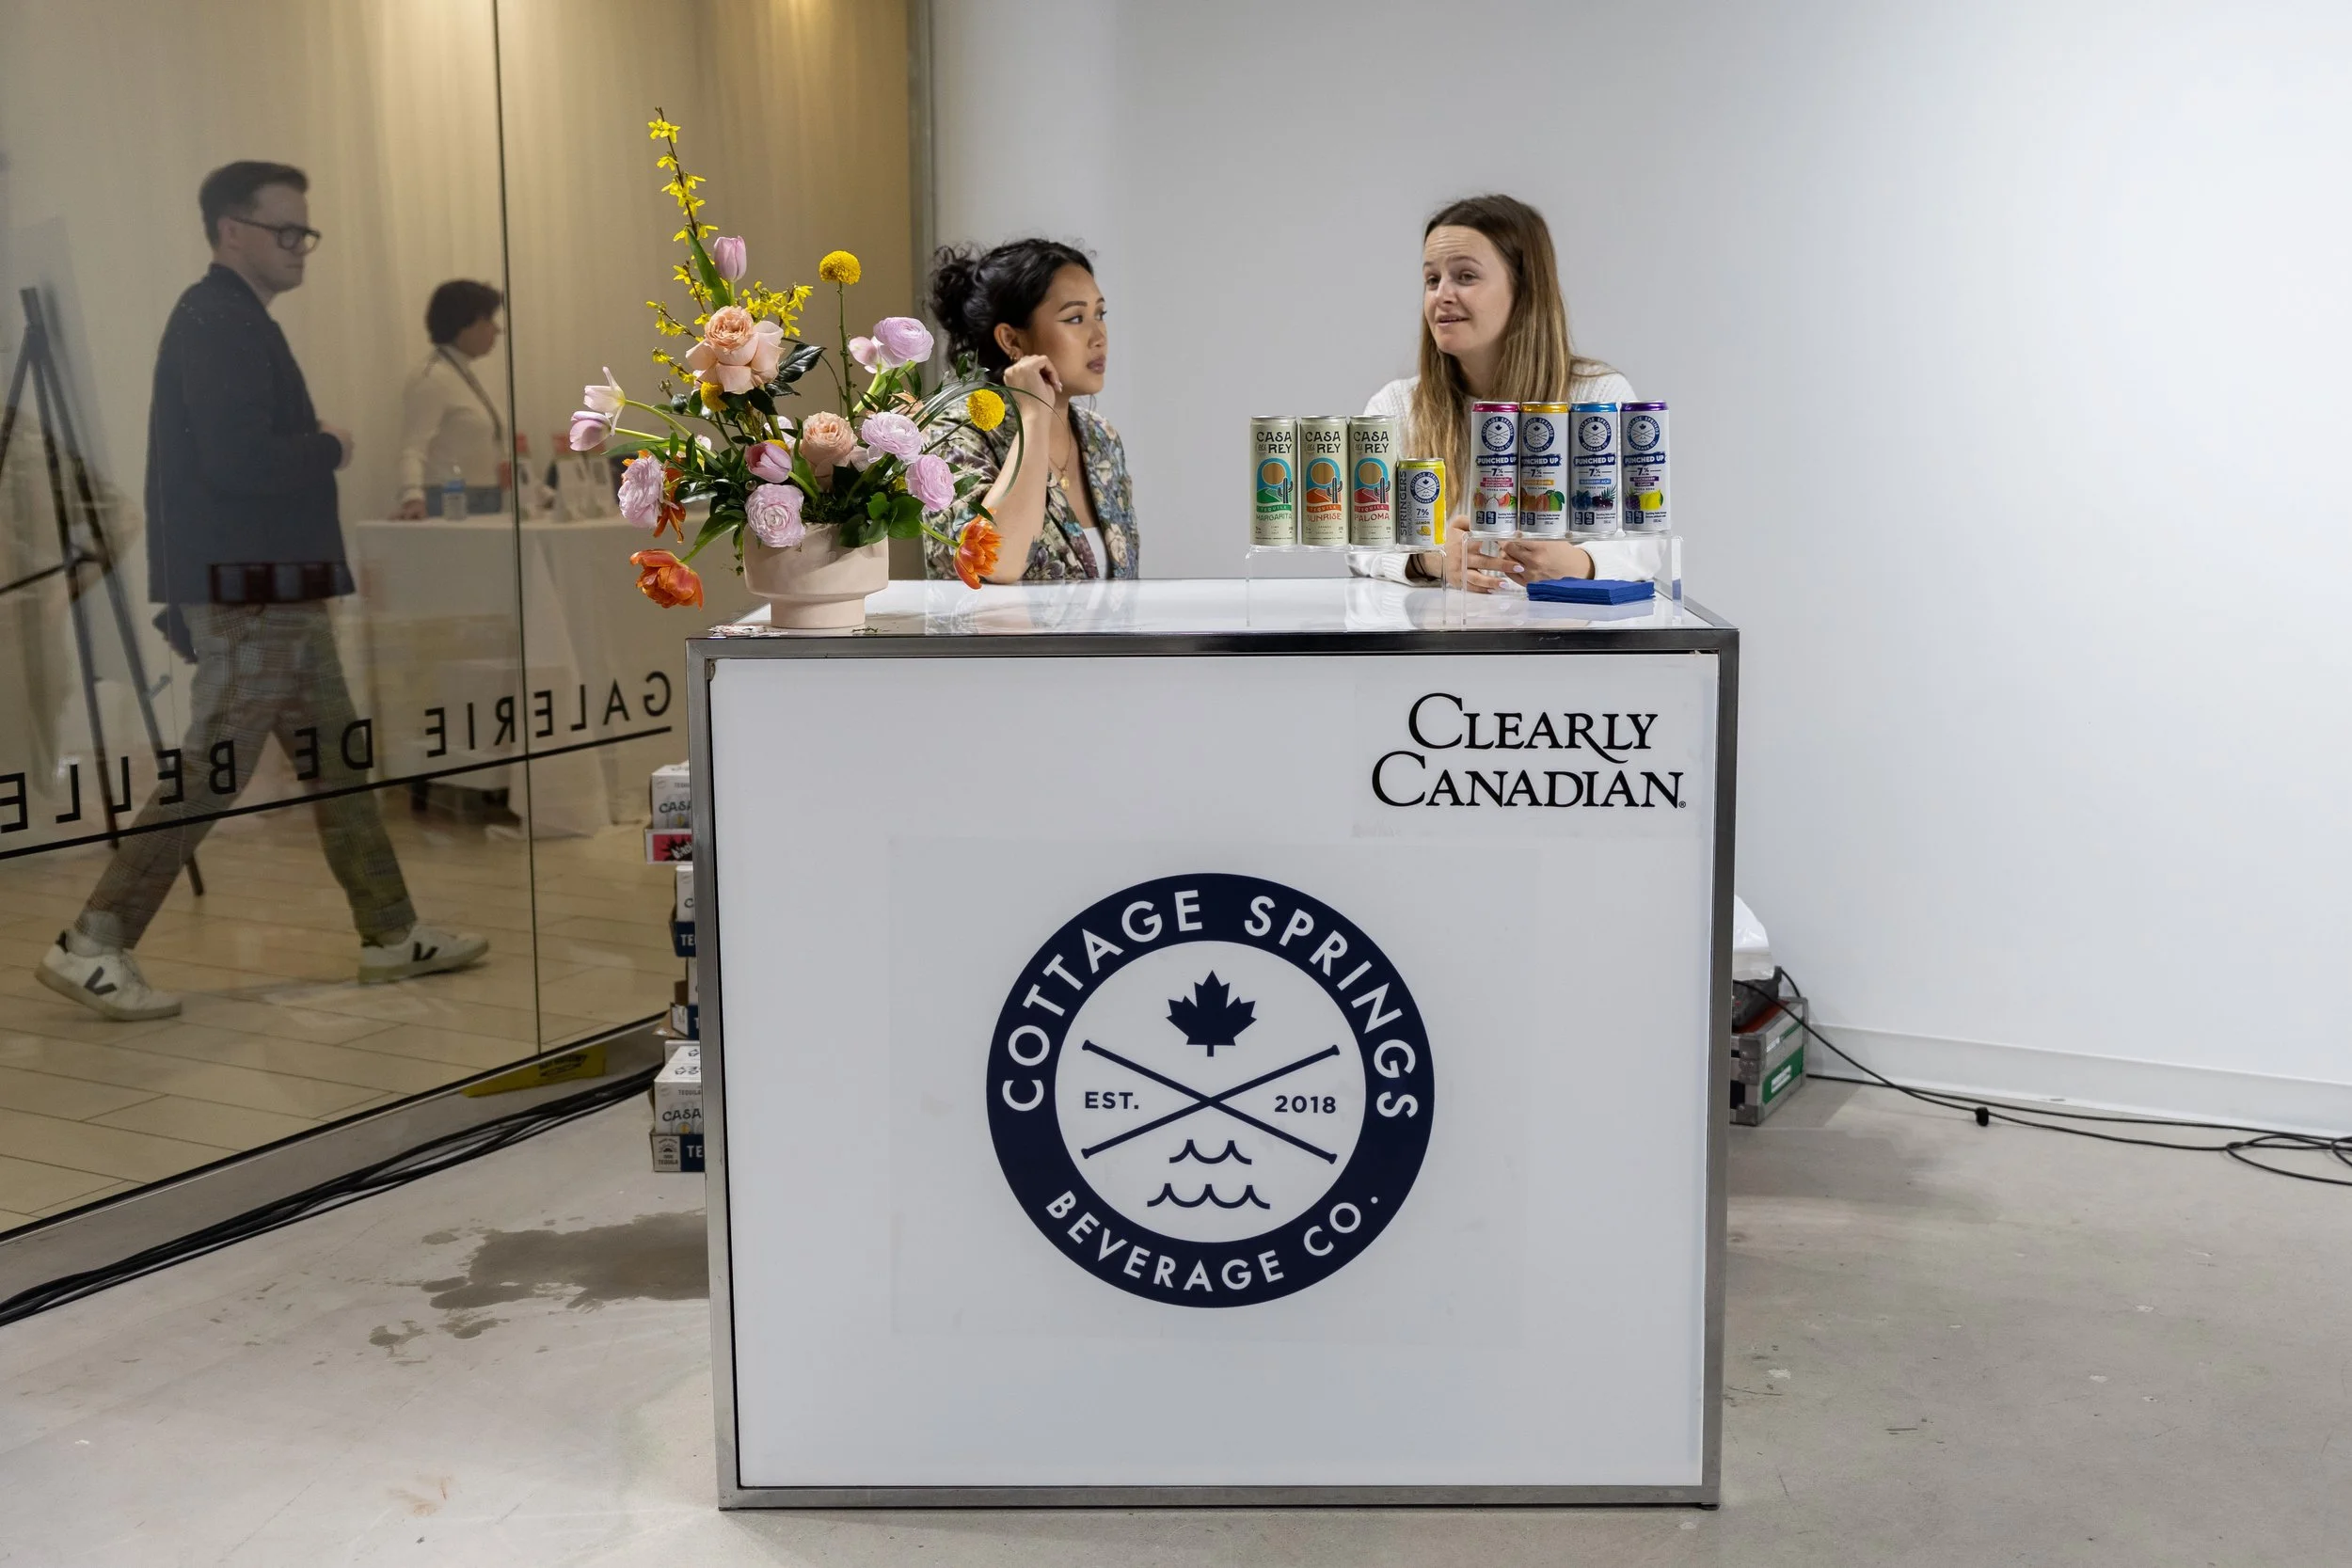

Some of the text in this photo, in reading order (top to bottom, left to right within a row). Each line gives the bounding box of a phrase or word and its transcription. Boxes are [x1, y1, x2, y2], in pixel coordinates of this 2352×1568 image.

[1257, 432, 1292, 442] CASA
[1305, 432, 1341, 442] CASA
[1354, 432, 1389, 442] CASA
[1268, 444, 1292, 453] REY
[1317, 444, 1341, 453] REY
[1365, 444, 1389, 453] REY
[1256, 513, 1293, 521] MARGARITA
[1307, 513, 1342, 522] SUNRISE
[1355, 513, 1390, 522] PALOMA
[1408, 692, 1659, 764] CLEARLY
[1001, 889, 1419, 1118] COTTAGE SPRINGS
[1084, 1092, 1139, 1110] EST.
[1274, 1095, 1337, 1115] 2018
[662, 1108, 702, 1122] CASA
[1045, 1190, 1379, 1292] BEVERAGE CO.
